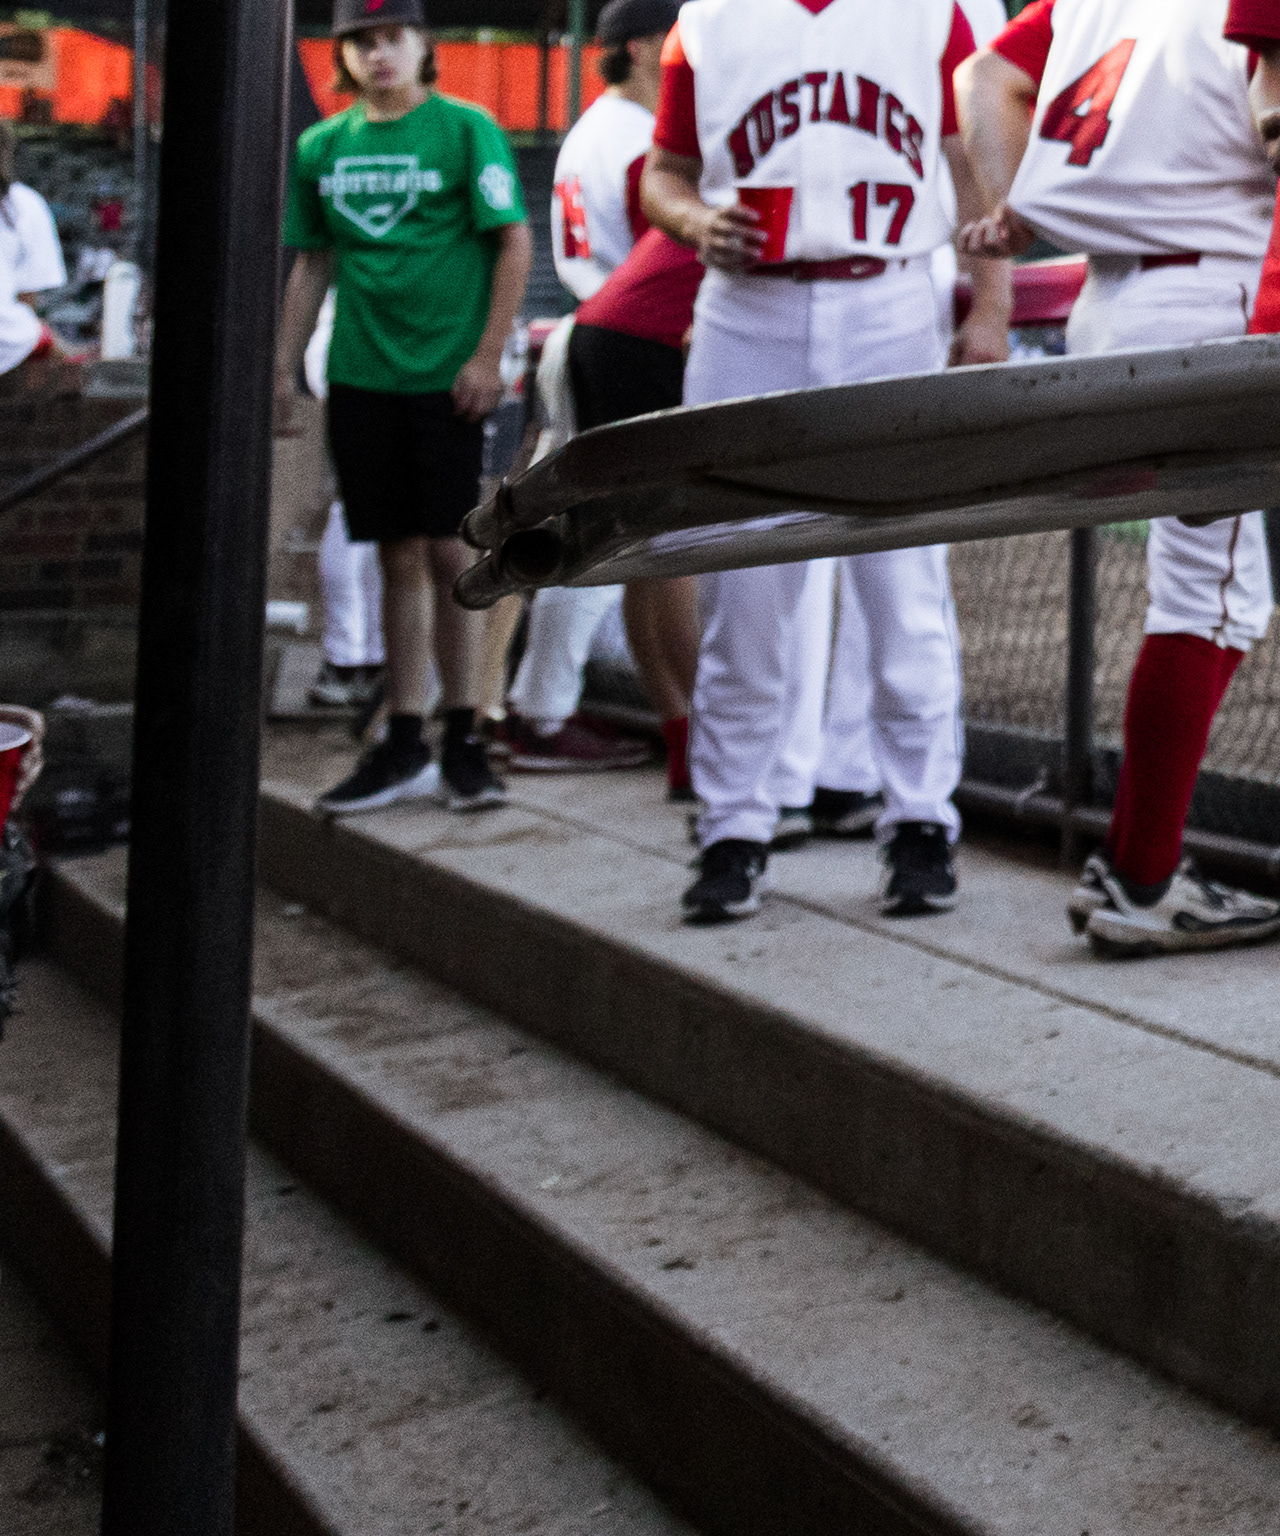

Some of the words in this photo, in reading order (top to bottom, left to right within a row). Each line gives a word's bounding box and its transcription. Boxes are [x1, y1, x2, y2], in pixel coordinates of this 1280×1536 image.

[726, 70, 925, 181] MUSTANGS
[1038, 38, 1138, 167] 4
[847, 180, 916, 248] 17
